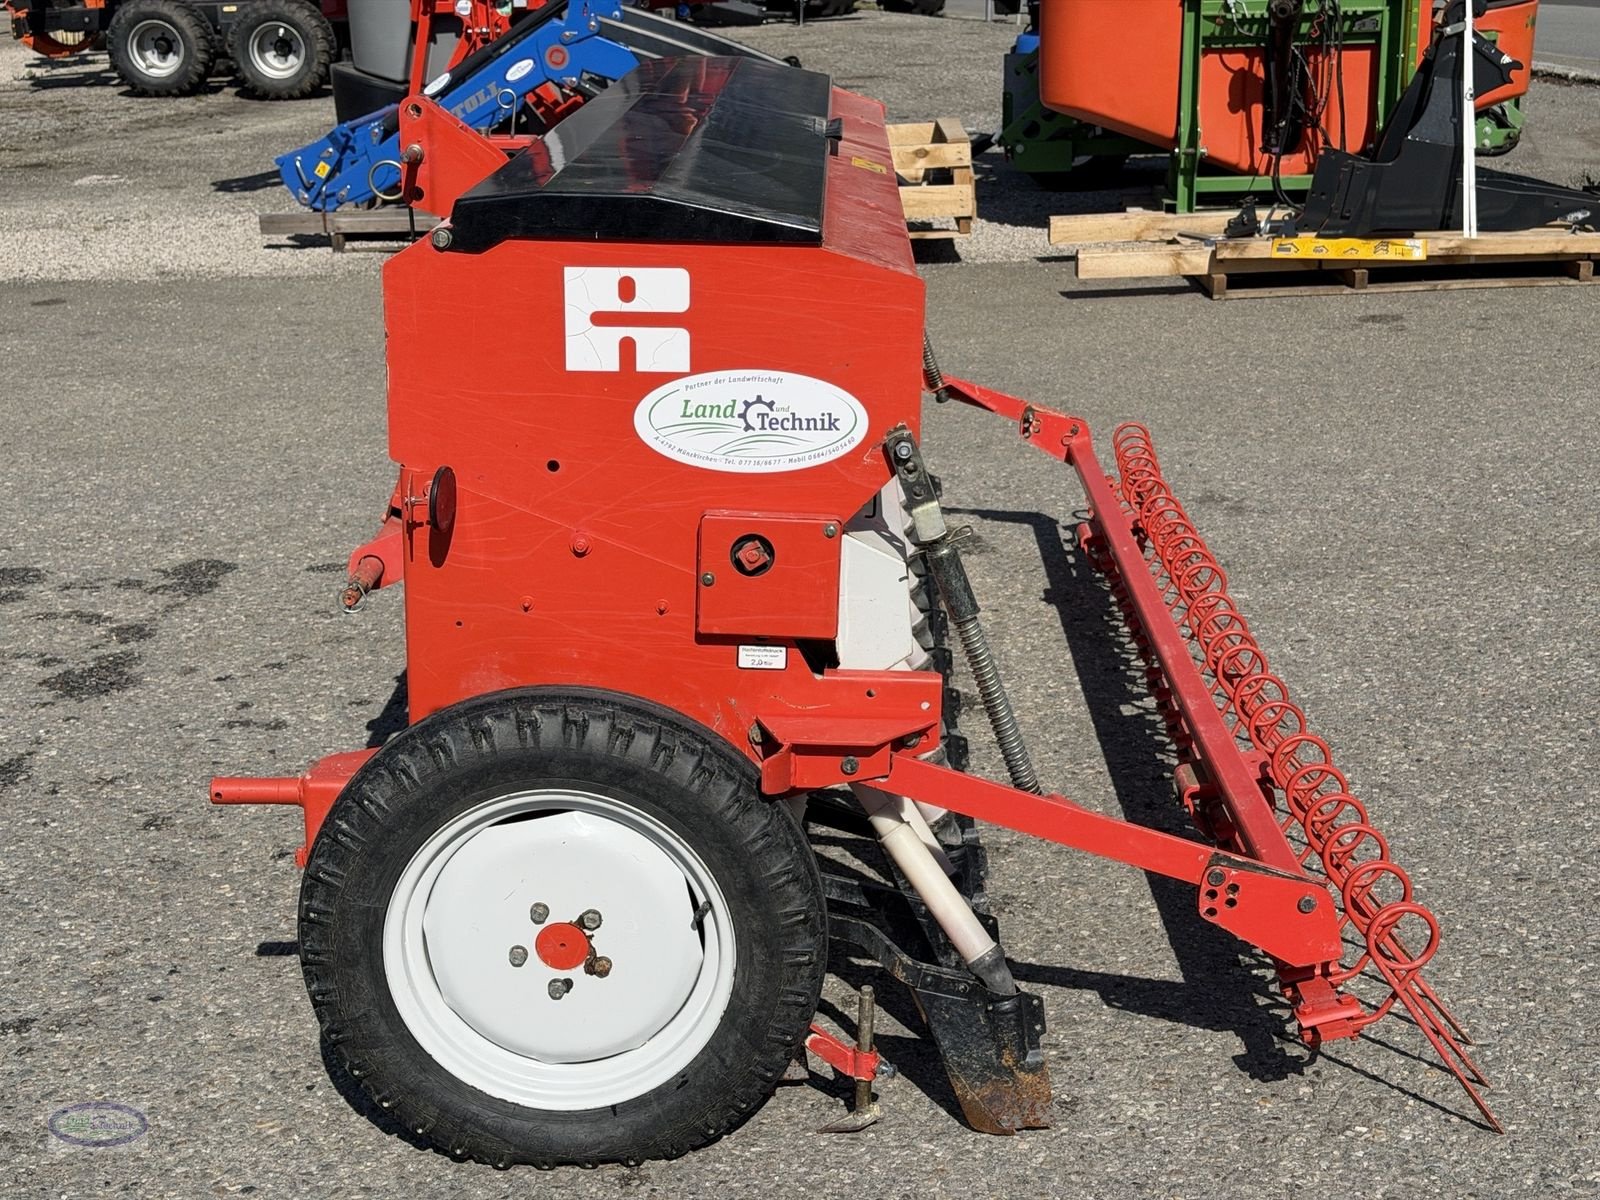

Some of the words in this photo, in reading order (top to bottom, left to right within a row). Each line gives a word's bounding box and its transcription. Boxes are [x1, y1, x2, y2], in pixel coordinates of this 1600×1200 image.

[450, 81, 501, 117] TOLL
[685, 381, 712, 391] Partner
[714, 377, 726, 385] der
[728, 375, 783, 385] Landwirtschaft
[680, 399, 737, 419] Land
[757, 412, 840, 431] Technik
[788, 455, 806, 464] Mobil
